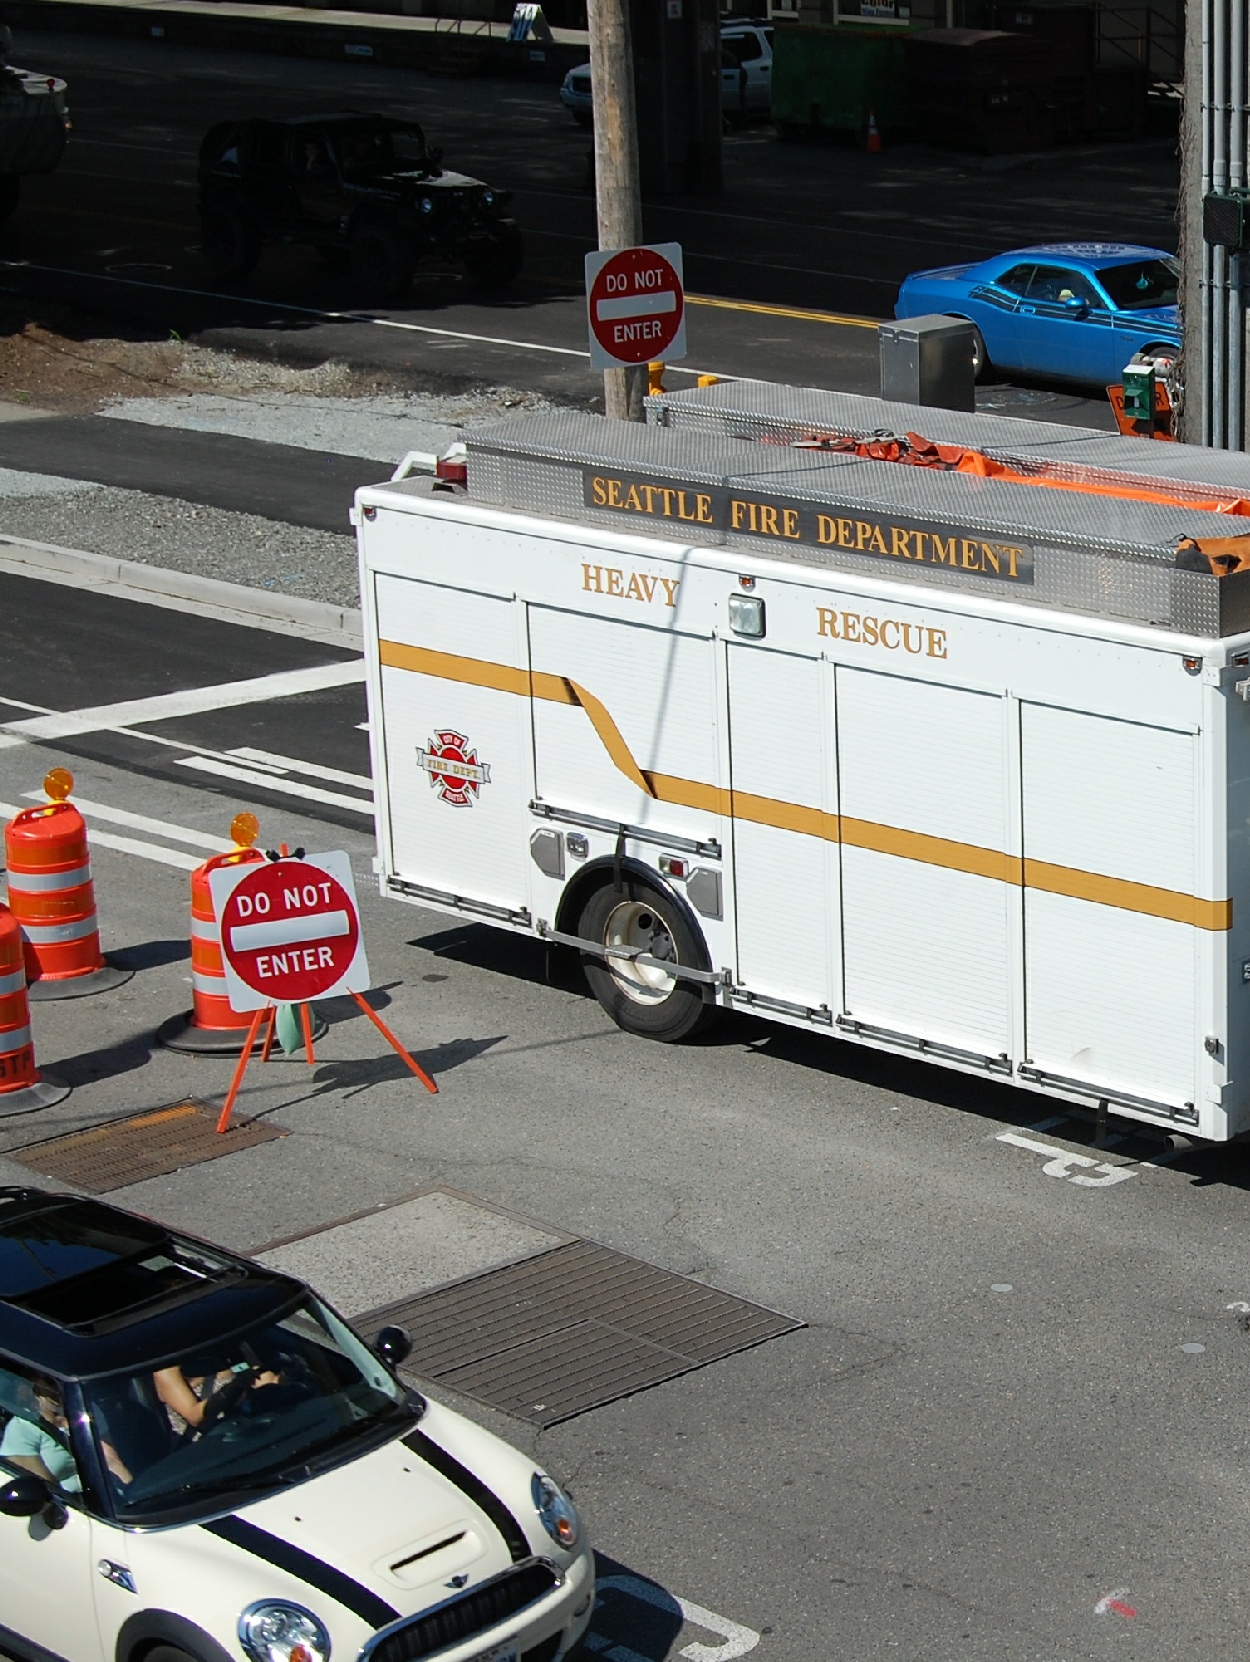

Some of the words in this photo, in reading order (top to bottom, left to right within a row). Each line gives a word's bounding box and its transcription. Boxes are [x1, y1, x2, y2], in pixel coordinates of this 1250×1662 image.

[606, 273, 627, 292] DO
[634, 269, 663, 289] NOT
[613, 320, 662, 343] ENTER
[592, 477, 713, 523] SEATTLE
[730, 499, 800, 539] FIRE
[816, 513, 1024, 578] DEPARTMENT
[582, 564, 680, 607] HEAVY
[816, 607, 947, 659] RESCUE
[427, 759, 448, 771] FIRE
[236, 892, 270, 917] DO
[284, 882, 331, 910] NOT
[256, 946, 334, 978] ENTER
